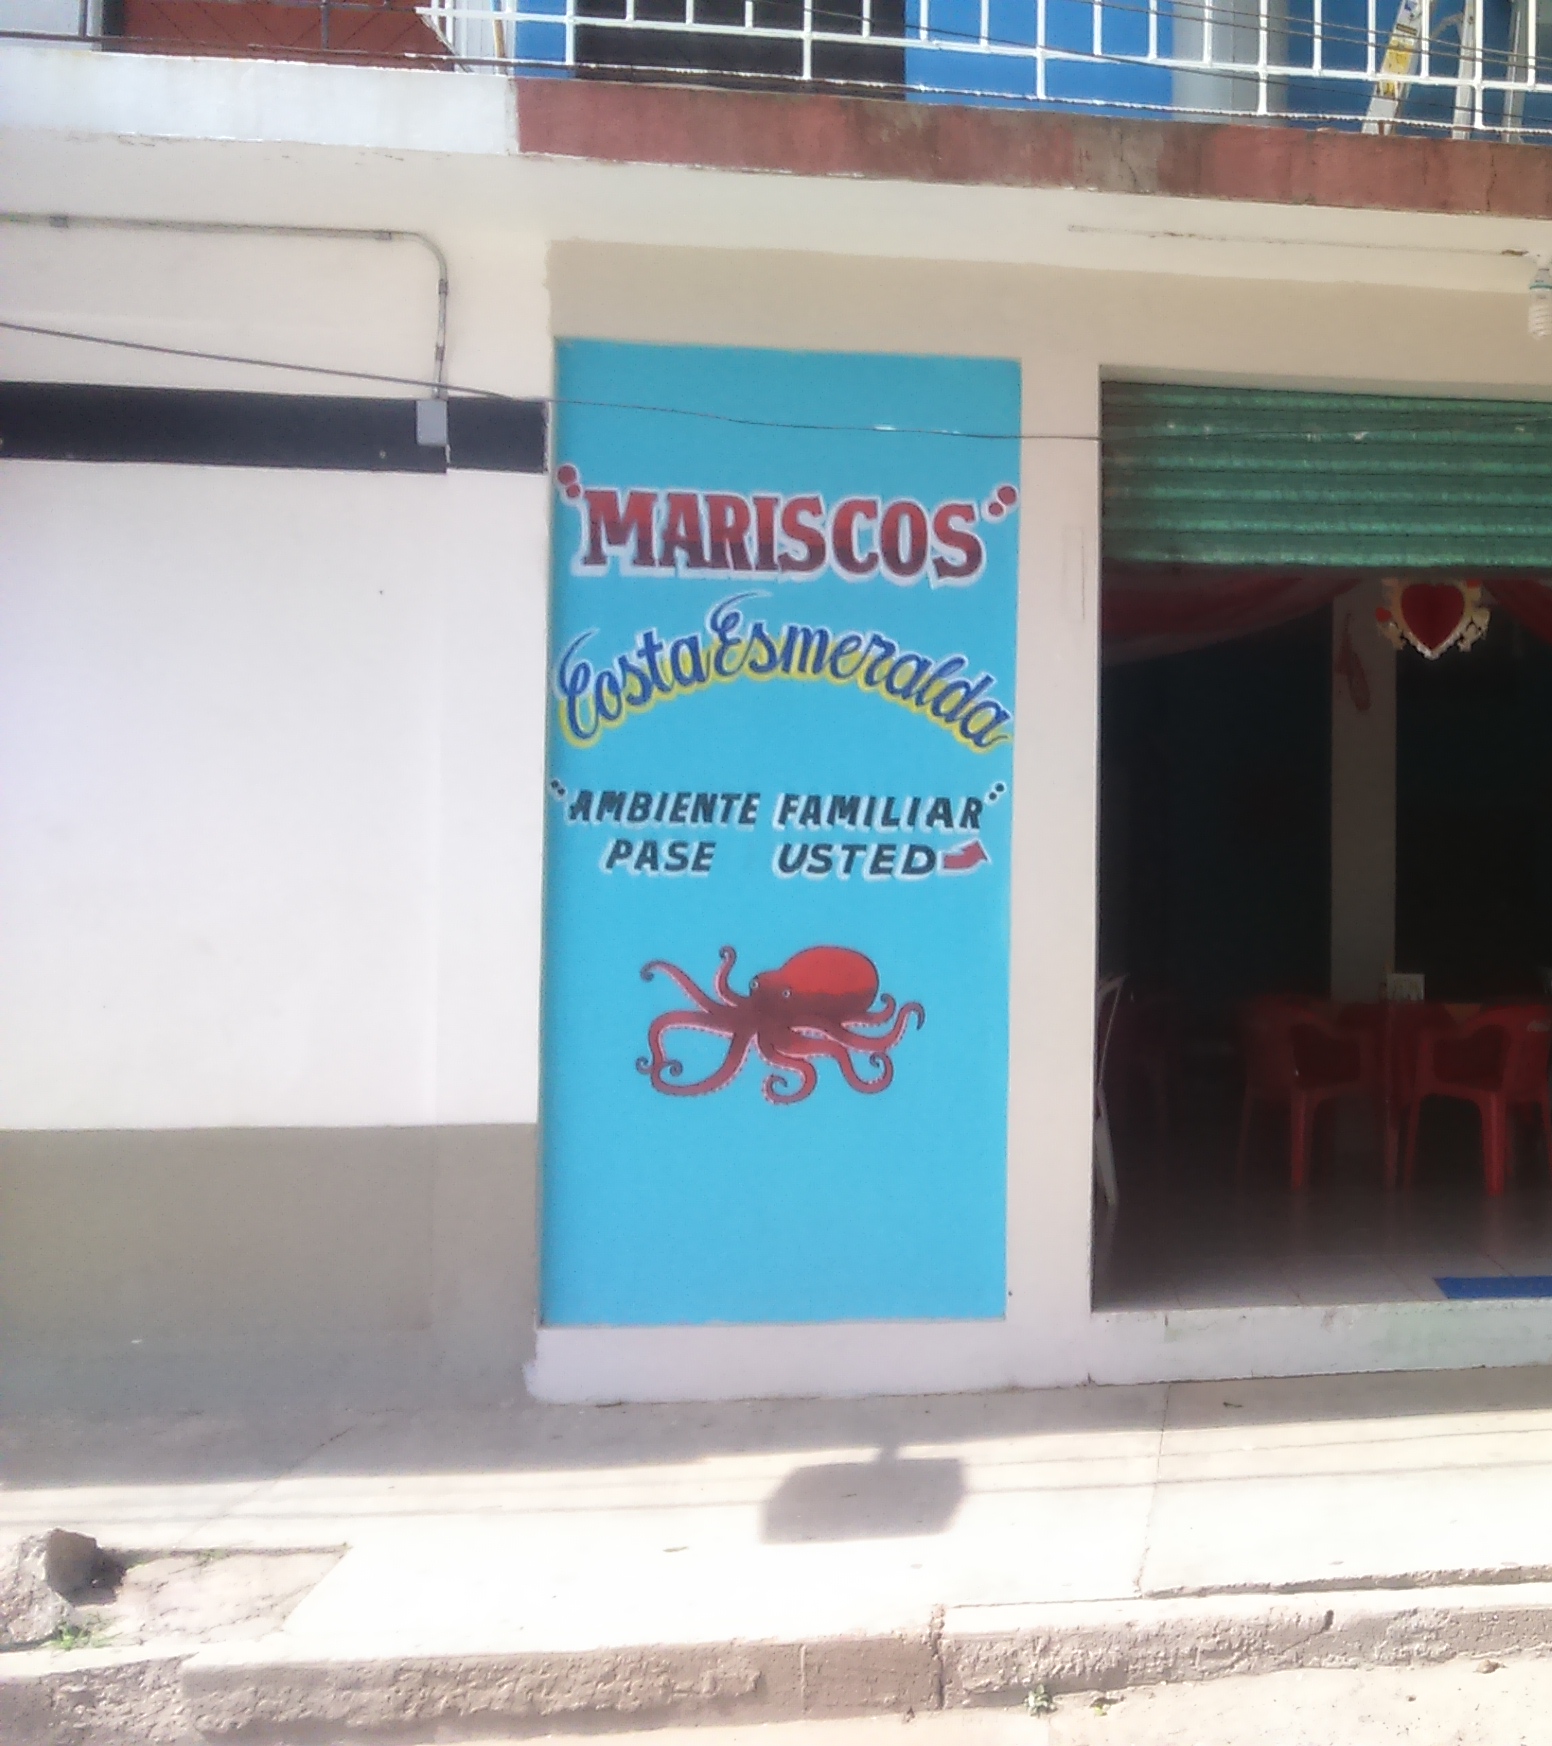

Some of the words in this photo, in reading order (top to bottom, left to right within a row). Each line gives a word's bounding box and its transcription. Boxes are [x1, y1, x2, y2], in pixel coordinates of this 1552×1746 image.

[558, 627, 712, 748] Costa
[709, 588, 1015, 754] Esmeralda
[602, 838, 719, 875] PASE
[774, 840, 939, 880] USTED
